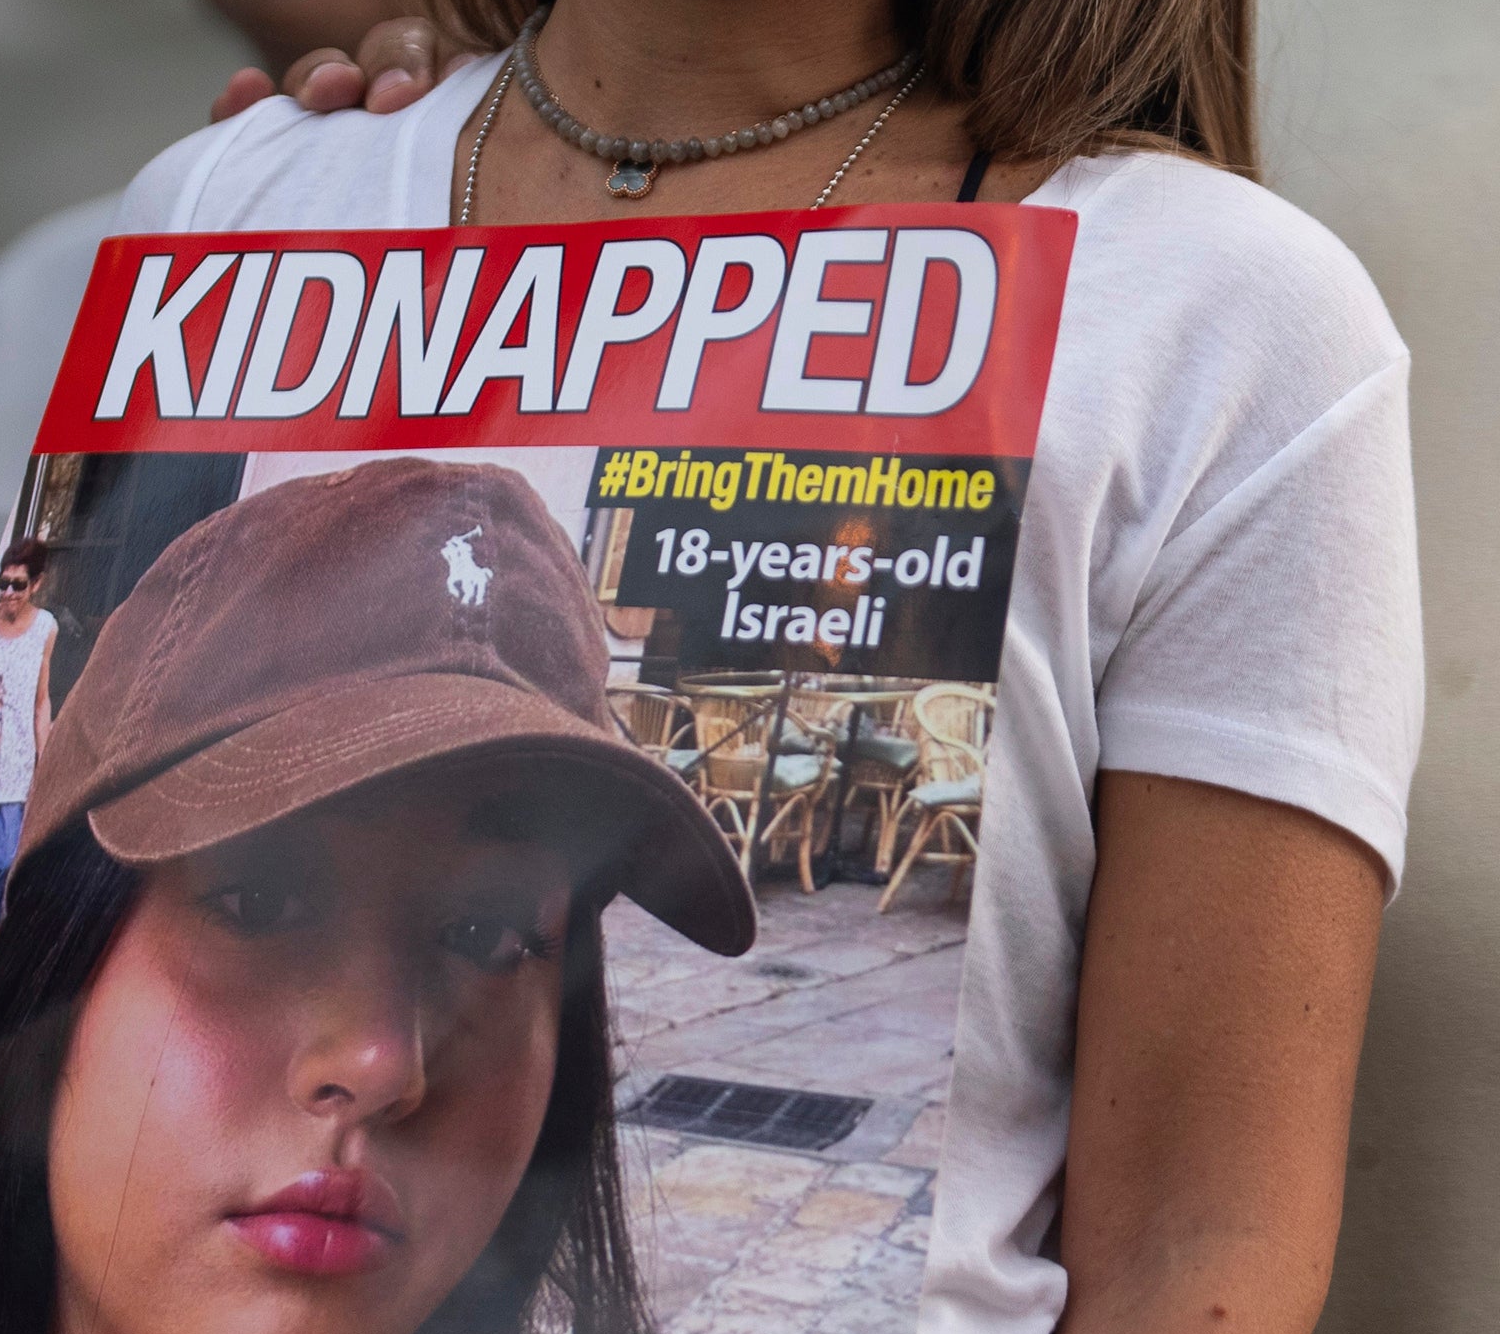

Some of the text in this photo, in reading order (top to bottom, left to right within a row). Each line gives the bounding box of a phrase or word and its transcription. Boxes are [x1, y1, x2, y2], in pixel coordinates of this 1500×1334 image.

[95, 227, 998, 421] KIDNAPPED
[598, 449, 994, 509] #BringThemHome
[652, 529, 984, 591] 18-years-old
[719, 592, 885, 647] Israeli
